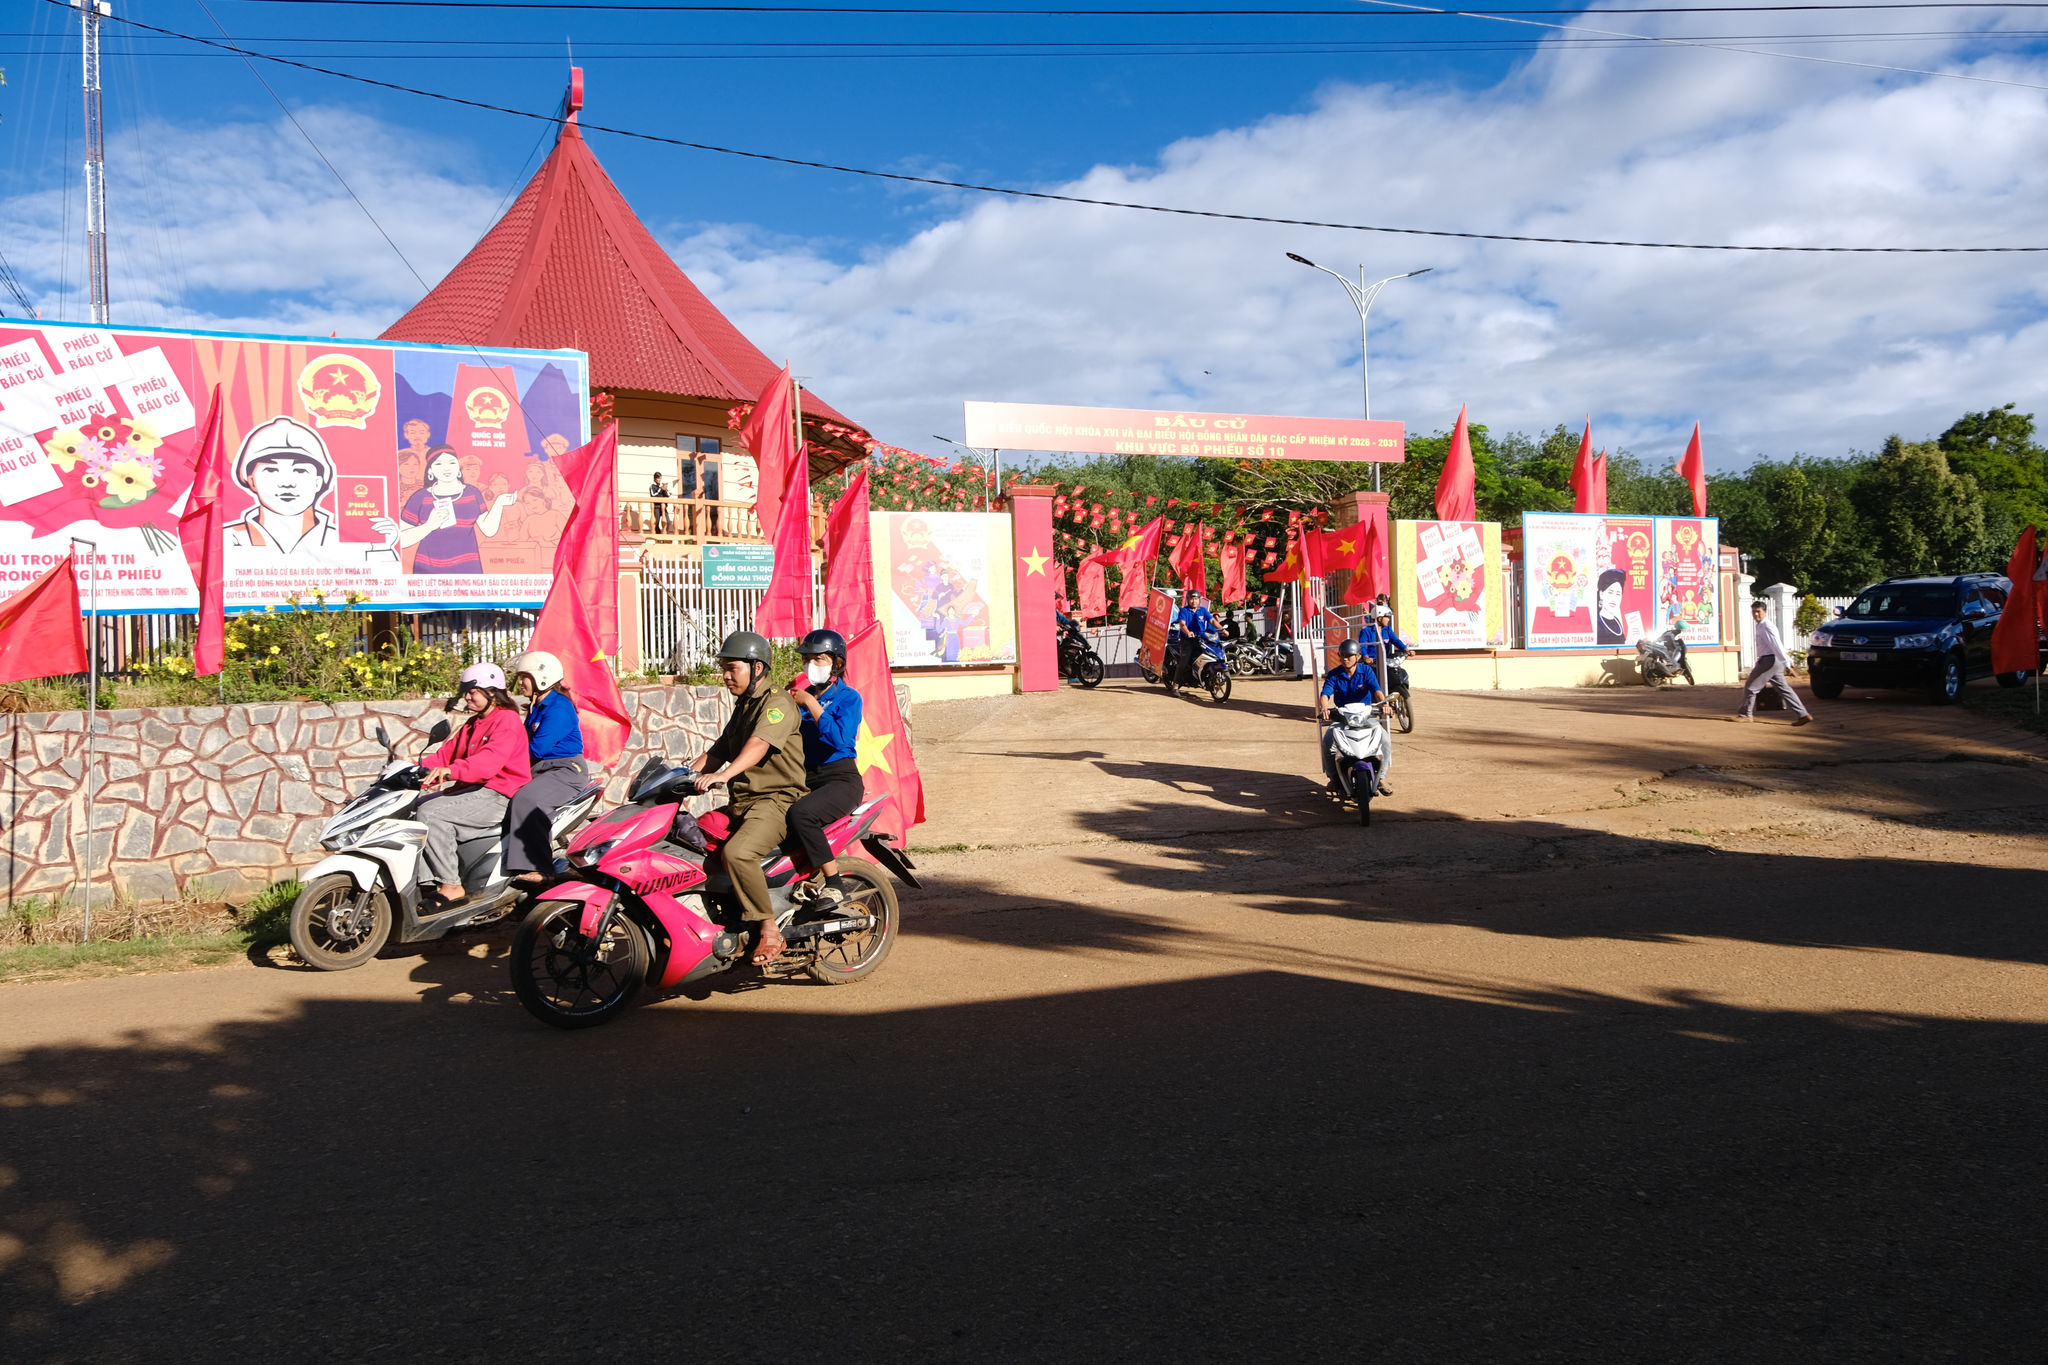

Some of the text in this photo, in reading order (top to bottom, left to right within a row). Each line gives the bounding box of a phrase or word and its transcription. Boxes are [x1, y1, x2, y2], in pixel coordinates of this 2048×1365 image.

[63, 332, 100, 353] PHIẾU
[0, 350, 31, 369] HIẾU
[132, 376, 168, 396] PHIẾU
[55, 386, 92, 407] PHIẾU
[1155, 413, 1206, 428] BẦU
[1104, 428, 1119, 438] XVI
[1122, 427, 1134, 438] VÀ
[1224, 430, 1248, 442] NHÂN
[1250, 431, 1268, 443] DÂN
[1270, 431, 1287, 444] CÁC
[1350, 437, 1370, 447] 2026
[1378, 438, 1398, 448] 2031
[1116, 441, 1144, 452] KHU
[1148, 441, 1177, 455] VỰC
[1204, 442, 1243, 456] PHIẾU
[1247, 443, 1264, 456] SỐ
[1269, 447, 1285, 457] 10
[0, 457, 18, 475] ẦU
[0, 552, 16, 565] ỬI
[112, 554, 135, 565] TIN
[0, 570, 42, 581] RONG
[759, 565, 774, 573] DỊC
[752, 575, 773, 583] THƯỢ
[634, 869, 698, 897] WINNER
